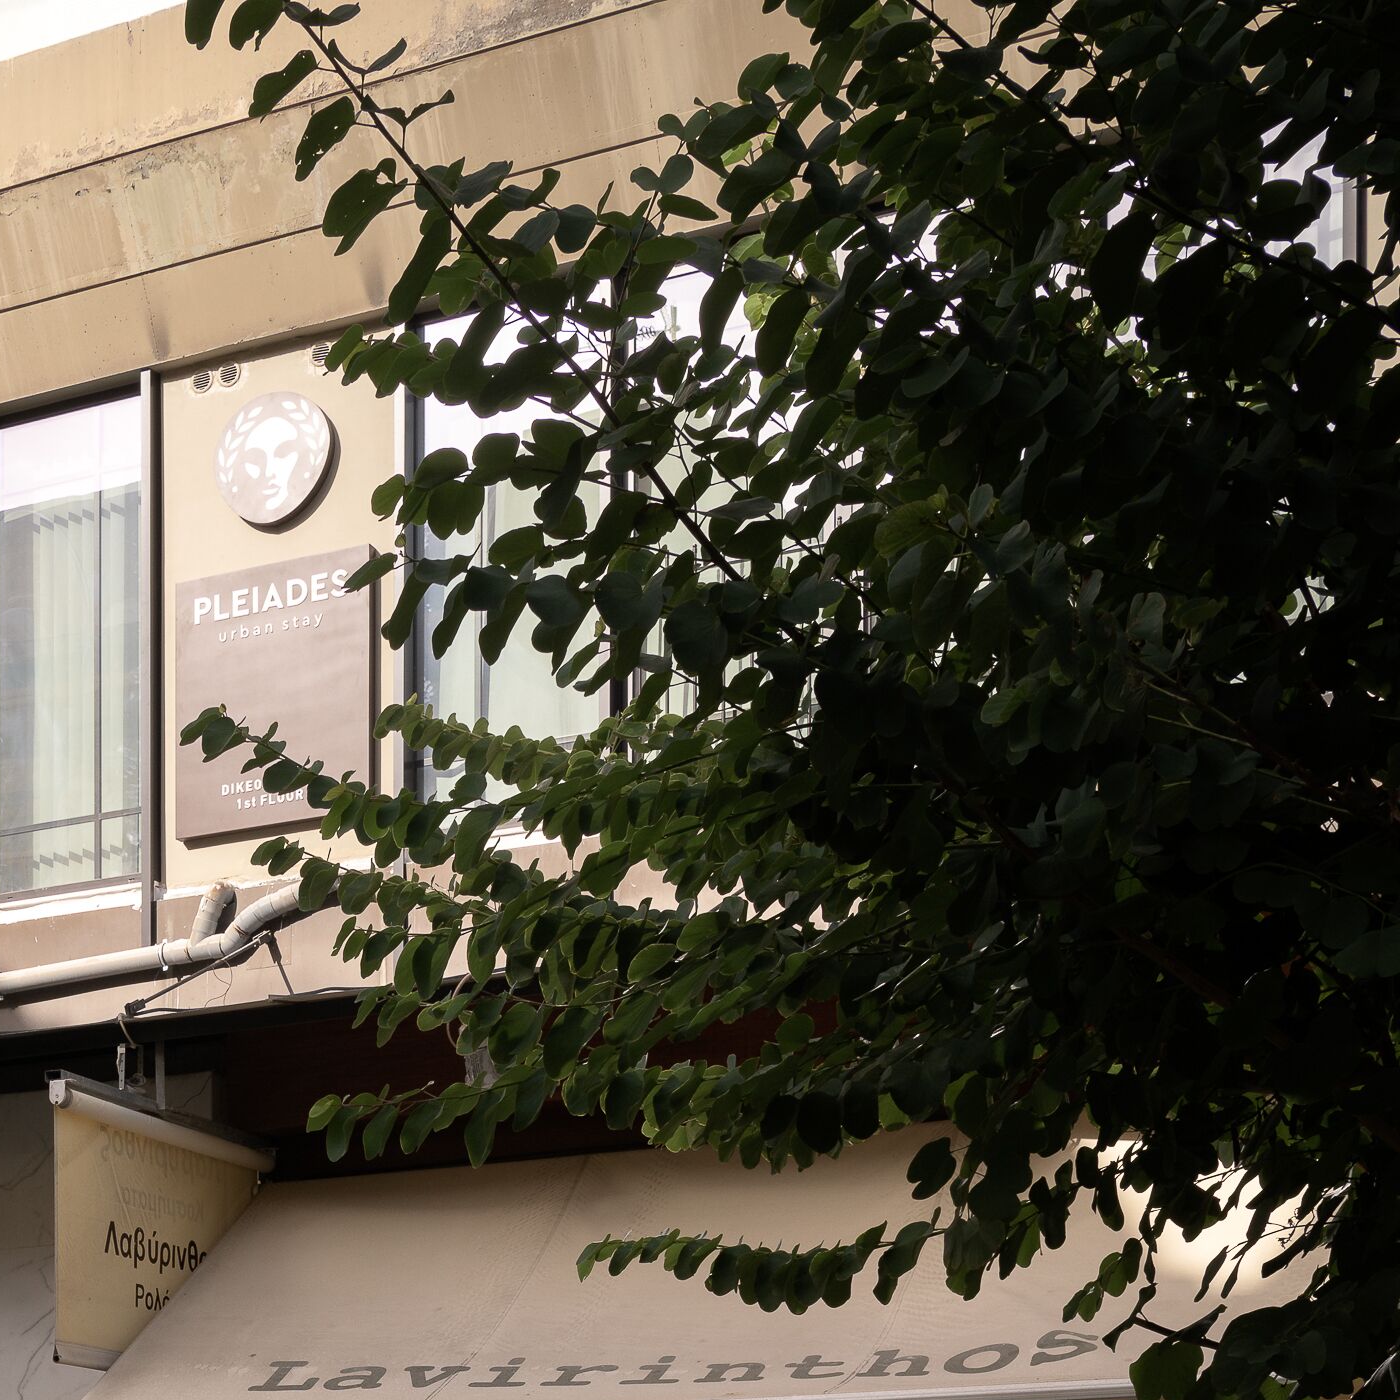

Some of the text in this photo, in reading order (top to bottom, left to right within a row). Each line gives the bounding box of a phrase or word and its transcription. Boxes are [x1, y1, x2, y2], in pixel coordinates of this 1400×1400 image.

[193, 568, 349, 625] PLEIADES
[218, 612, 324, 643] urban stay
[236, 789, 304, 810] 1st FLOOR
